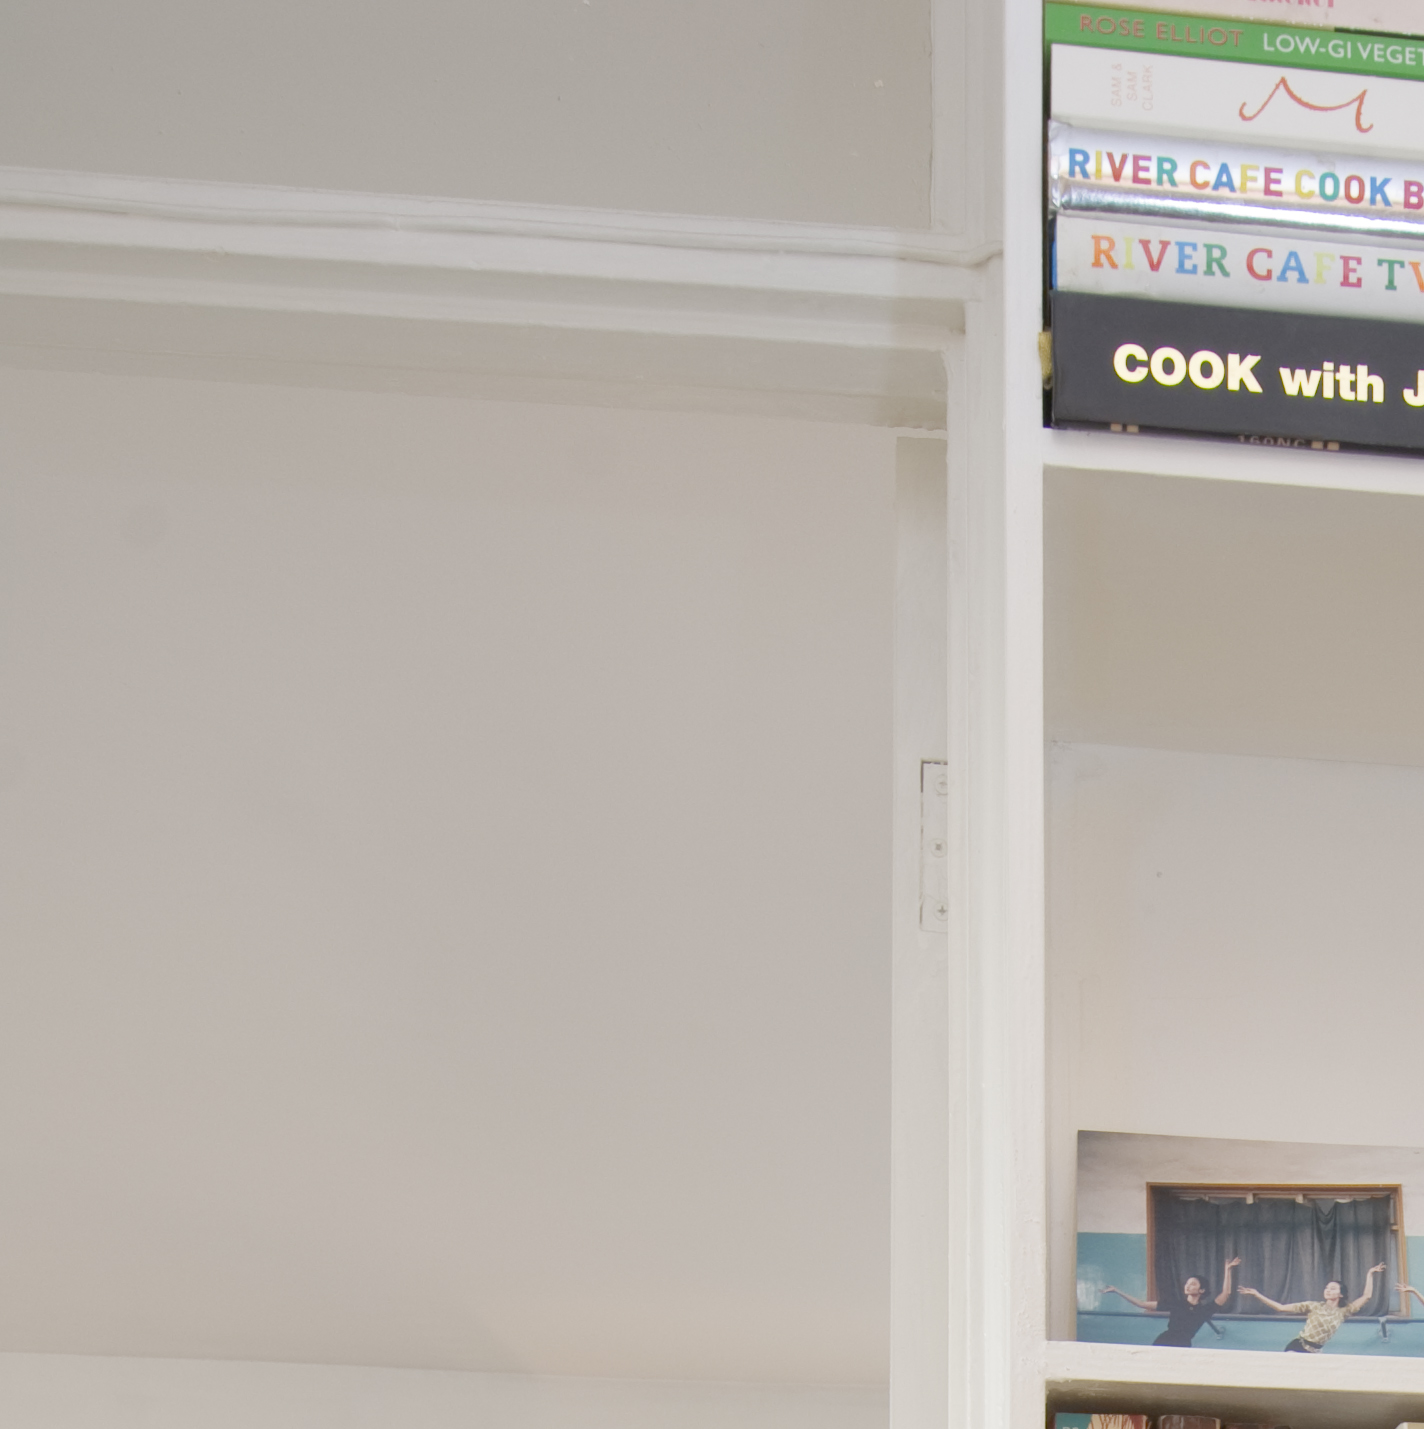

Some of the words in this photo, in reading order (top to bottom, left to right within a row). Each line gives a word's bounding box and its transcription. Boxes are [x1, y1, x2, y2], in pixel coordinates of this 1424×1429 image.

[1080, 14, 1144, 39] ROSE
[1156, 22, 1243, 47] ELLIOT
[1263, 33, 1351, 59] LOW-GI
[1068, 148, 1178, 187] RIVER
[1189, 160, 1283, 197] CAFE
[1295, 169, 1392, 207] COOK
[1091, 234, 1230, 278] RIVER
[1246, 248, 1362, 288] CAFE
[1113, 343, 1263, 393] COOK
[1279, 361, 1385, 403] with
